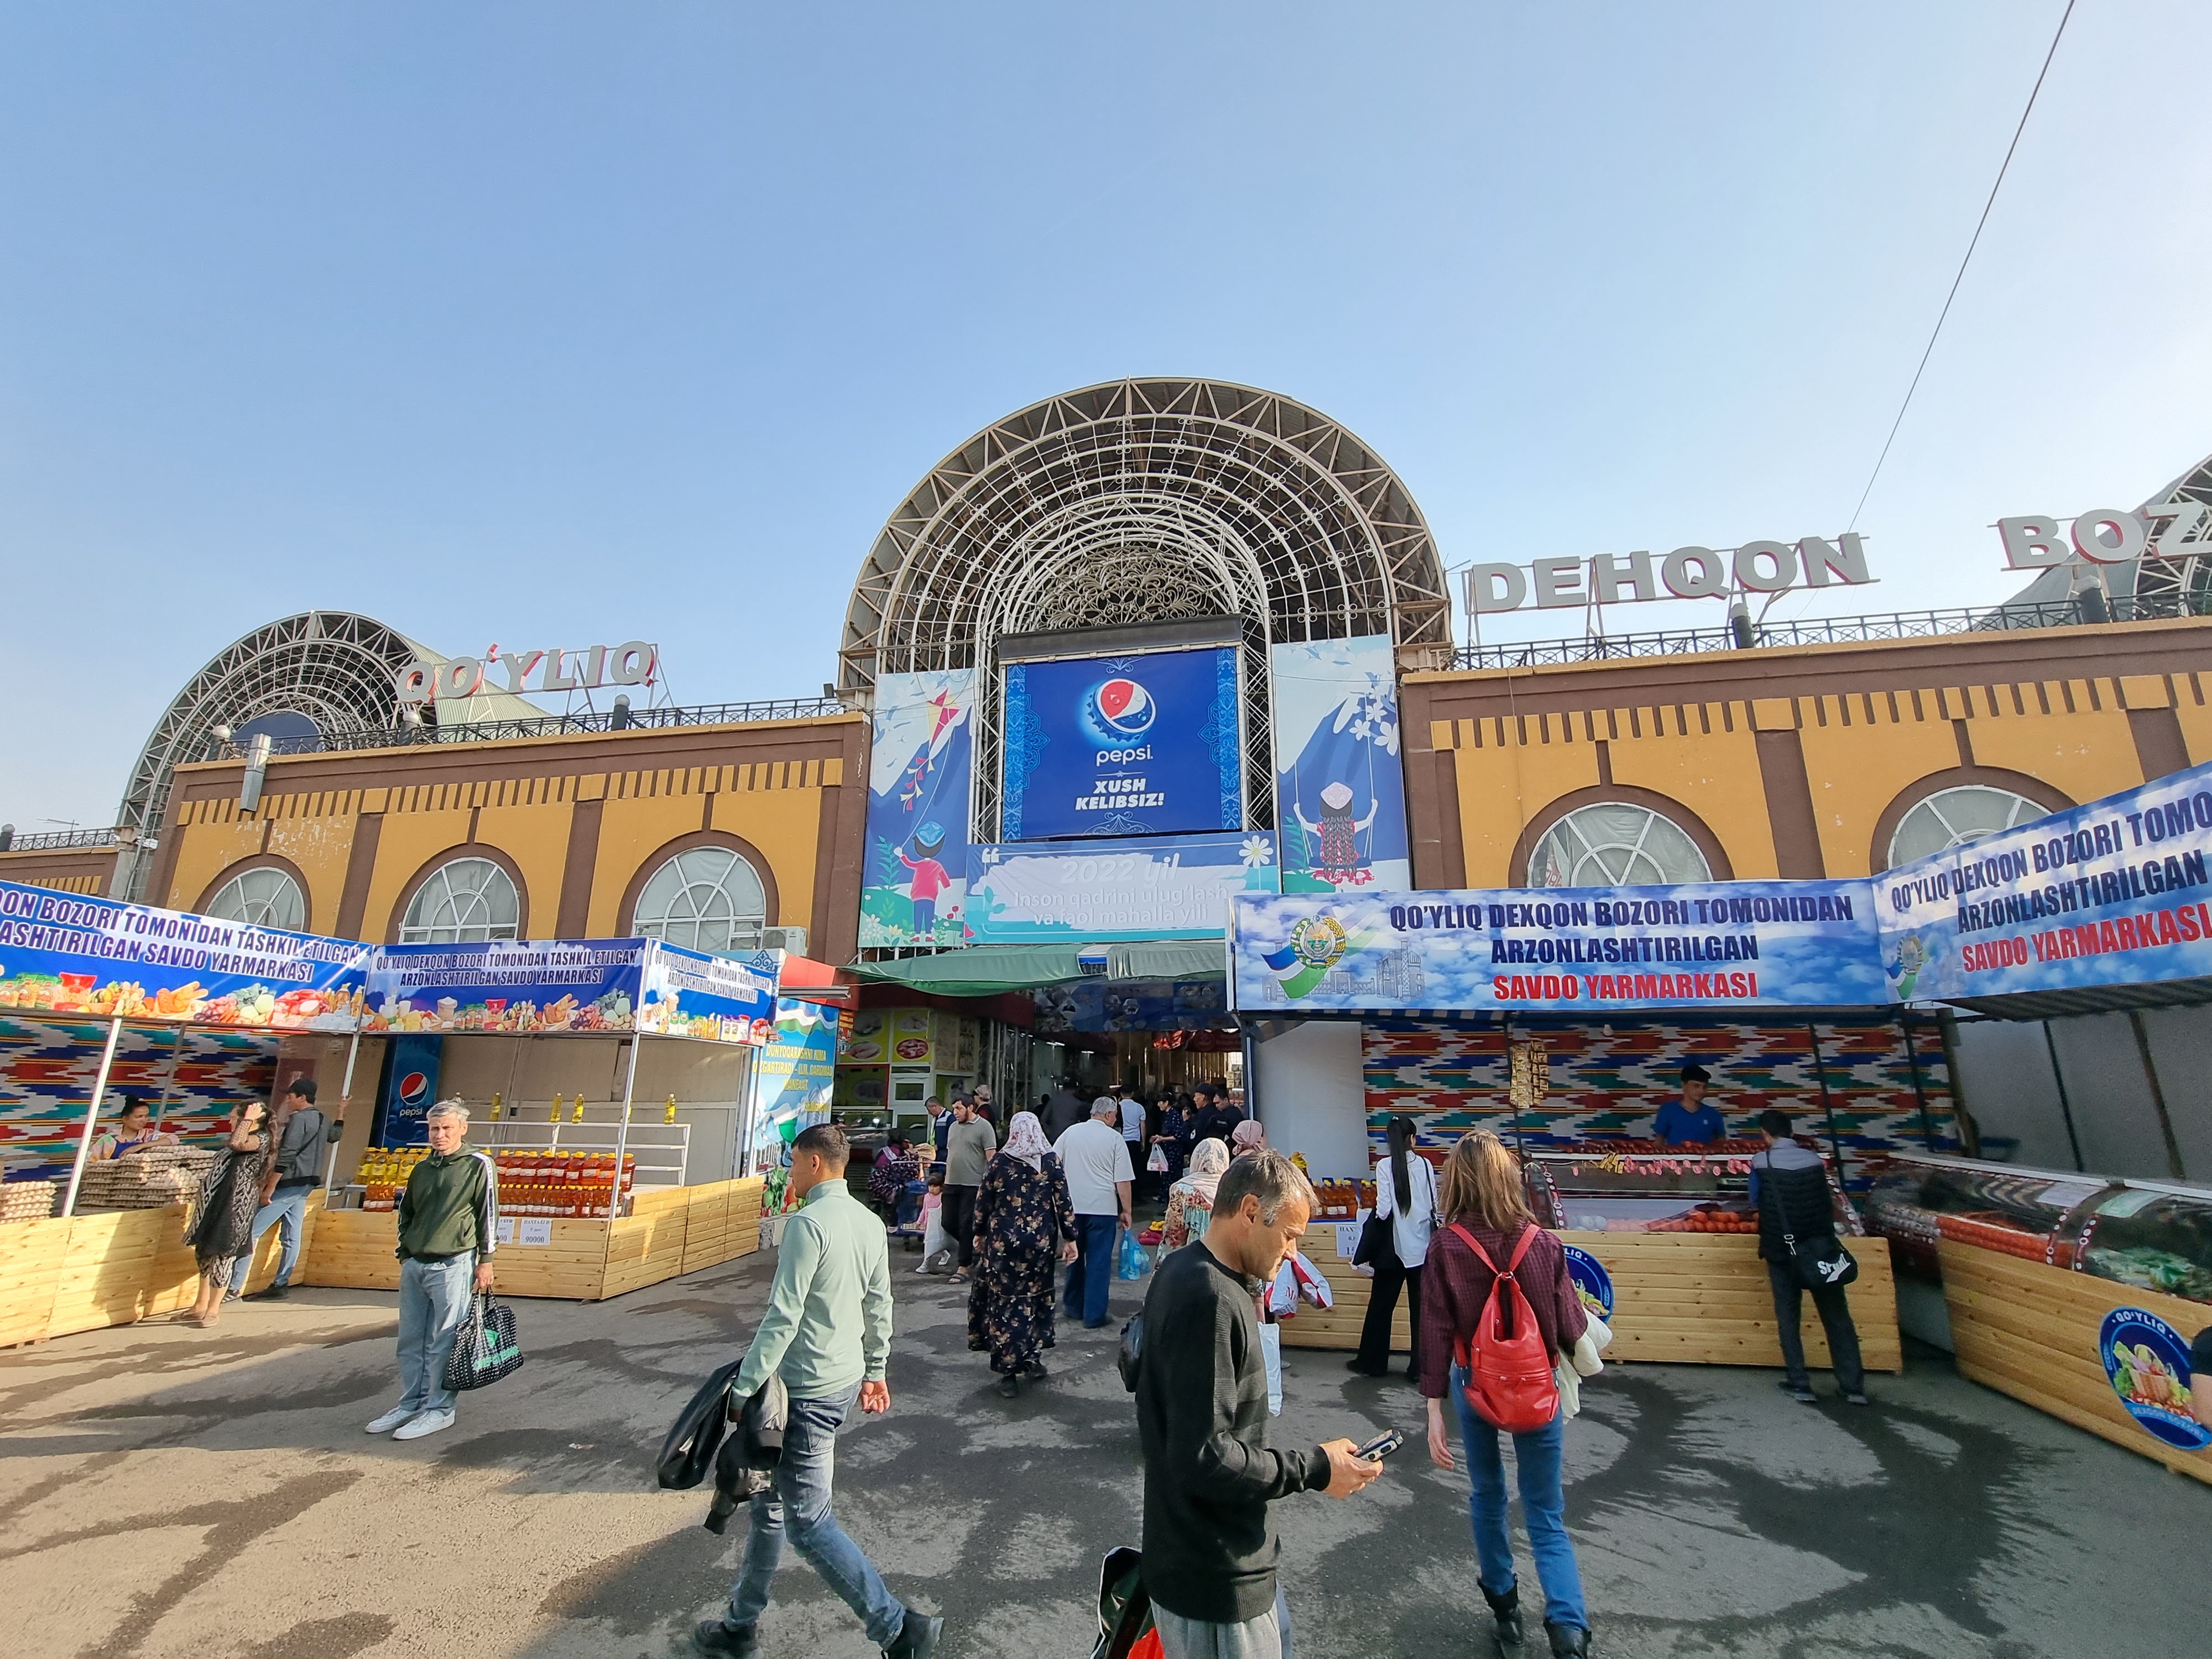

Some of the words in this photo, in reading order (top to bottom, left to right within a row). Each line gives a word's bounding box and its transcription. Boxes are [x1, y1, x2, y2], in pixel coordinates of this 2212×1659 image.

[1471, 532, 1872, 613] DEHQON
[1997, 501, 2212, 570] BOZ
[1096, 744, 1151, 767] pepsi
[1093, 778, 1146, 794] XUSH
[1075, 792, 1165, 810] KELIBSIZ!
[1891, 872, 1950, 913] QO'YLIQ
[1951, 849, 2028, 895] DEXQON
[2032, 820, 2124, 873] BOZORI
[2126, 791, 2212, 847] TOMO
[1062, 858, 1136, 884] 2022
[1145, 852, 1181, 888] yil
[1014, 891, 1065, 908] Inson
[1070, 886, 1136, 910] qadrini
[1958, 849, 2208, 933] ARZONLASHTIRILGAN
[1034, 912, 1054, 926] va
[1060, 907, 1094, 925] faol
[1100, 905, 1175, 924] mahalla
[1180, 904, 1208, 926] yili
[1390, 904, 1483, 932] QO'YLIQ
[1489, 901, 1589, 932] DEXQON
[1594, 899, 1688, 928] BOZORI
[1693, 895, 1854, 925] TOMONIDAN
[39, 898, 120, 930] BOZORI
[124, 911, 234, 946] TOMONIDAN
[237, 930, 299, 956] TASHKIL
[303, 940, 360, 964] ETILGAN
[1962, 936, 2028, 973] SAVDO
[2031, 902, 2212, 962] YARMARKASI
[0, 921, 142, 961] ASHTIRILGAN
[144, 942, 206, 969] SAVDO
[211, 952, 314, 982] YARMARKASI
[414, 955, 451, 970] DEXQON
[452, 954, 487, 968] BOZORI
[489, 952, 548, 967] TOMONIDAN
[551, 952, 592, 966] TASHKIL
[594, 950, 638, 965] ETILGAN
[1490, 935, 1759, 963] ARZONLASHTIRILGAN
[400, 972, 498, 987] ARZONLASHTIRILGAN
[500, 971, 533, 985] SAVDO
[535, 969, 604, 984] YARMARKASI
[1493, 975, 1579, 1000] SAVDO
[1583, 972, 1758, 999] YARMARKASI
[752, 1060, 794, 1074] OZGARTIRADI
[399, 1107, 422, 1118] pepsi
[1563, 1248, 1583, 1260] LIQ
